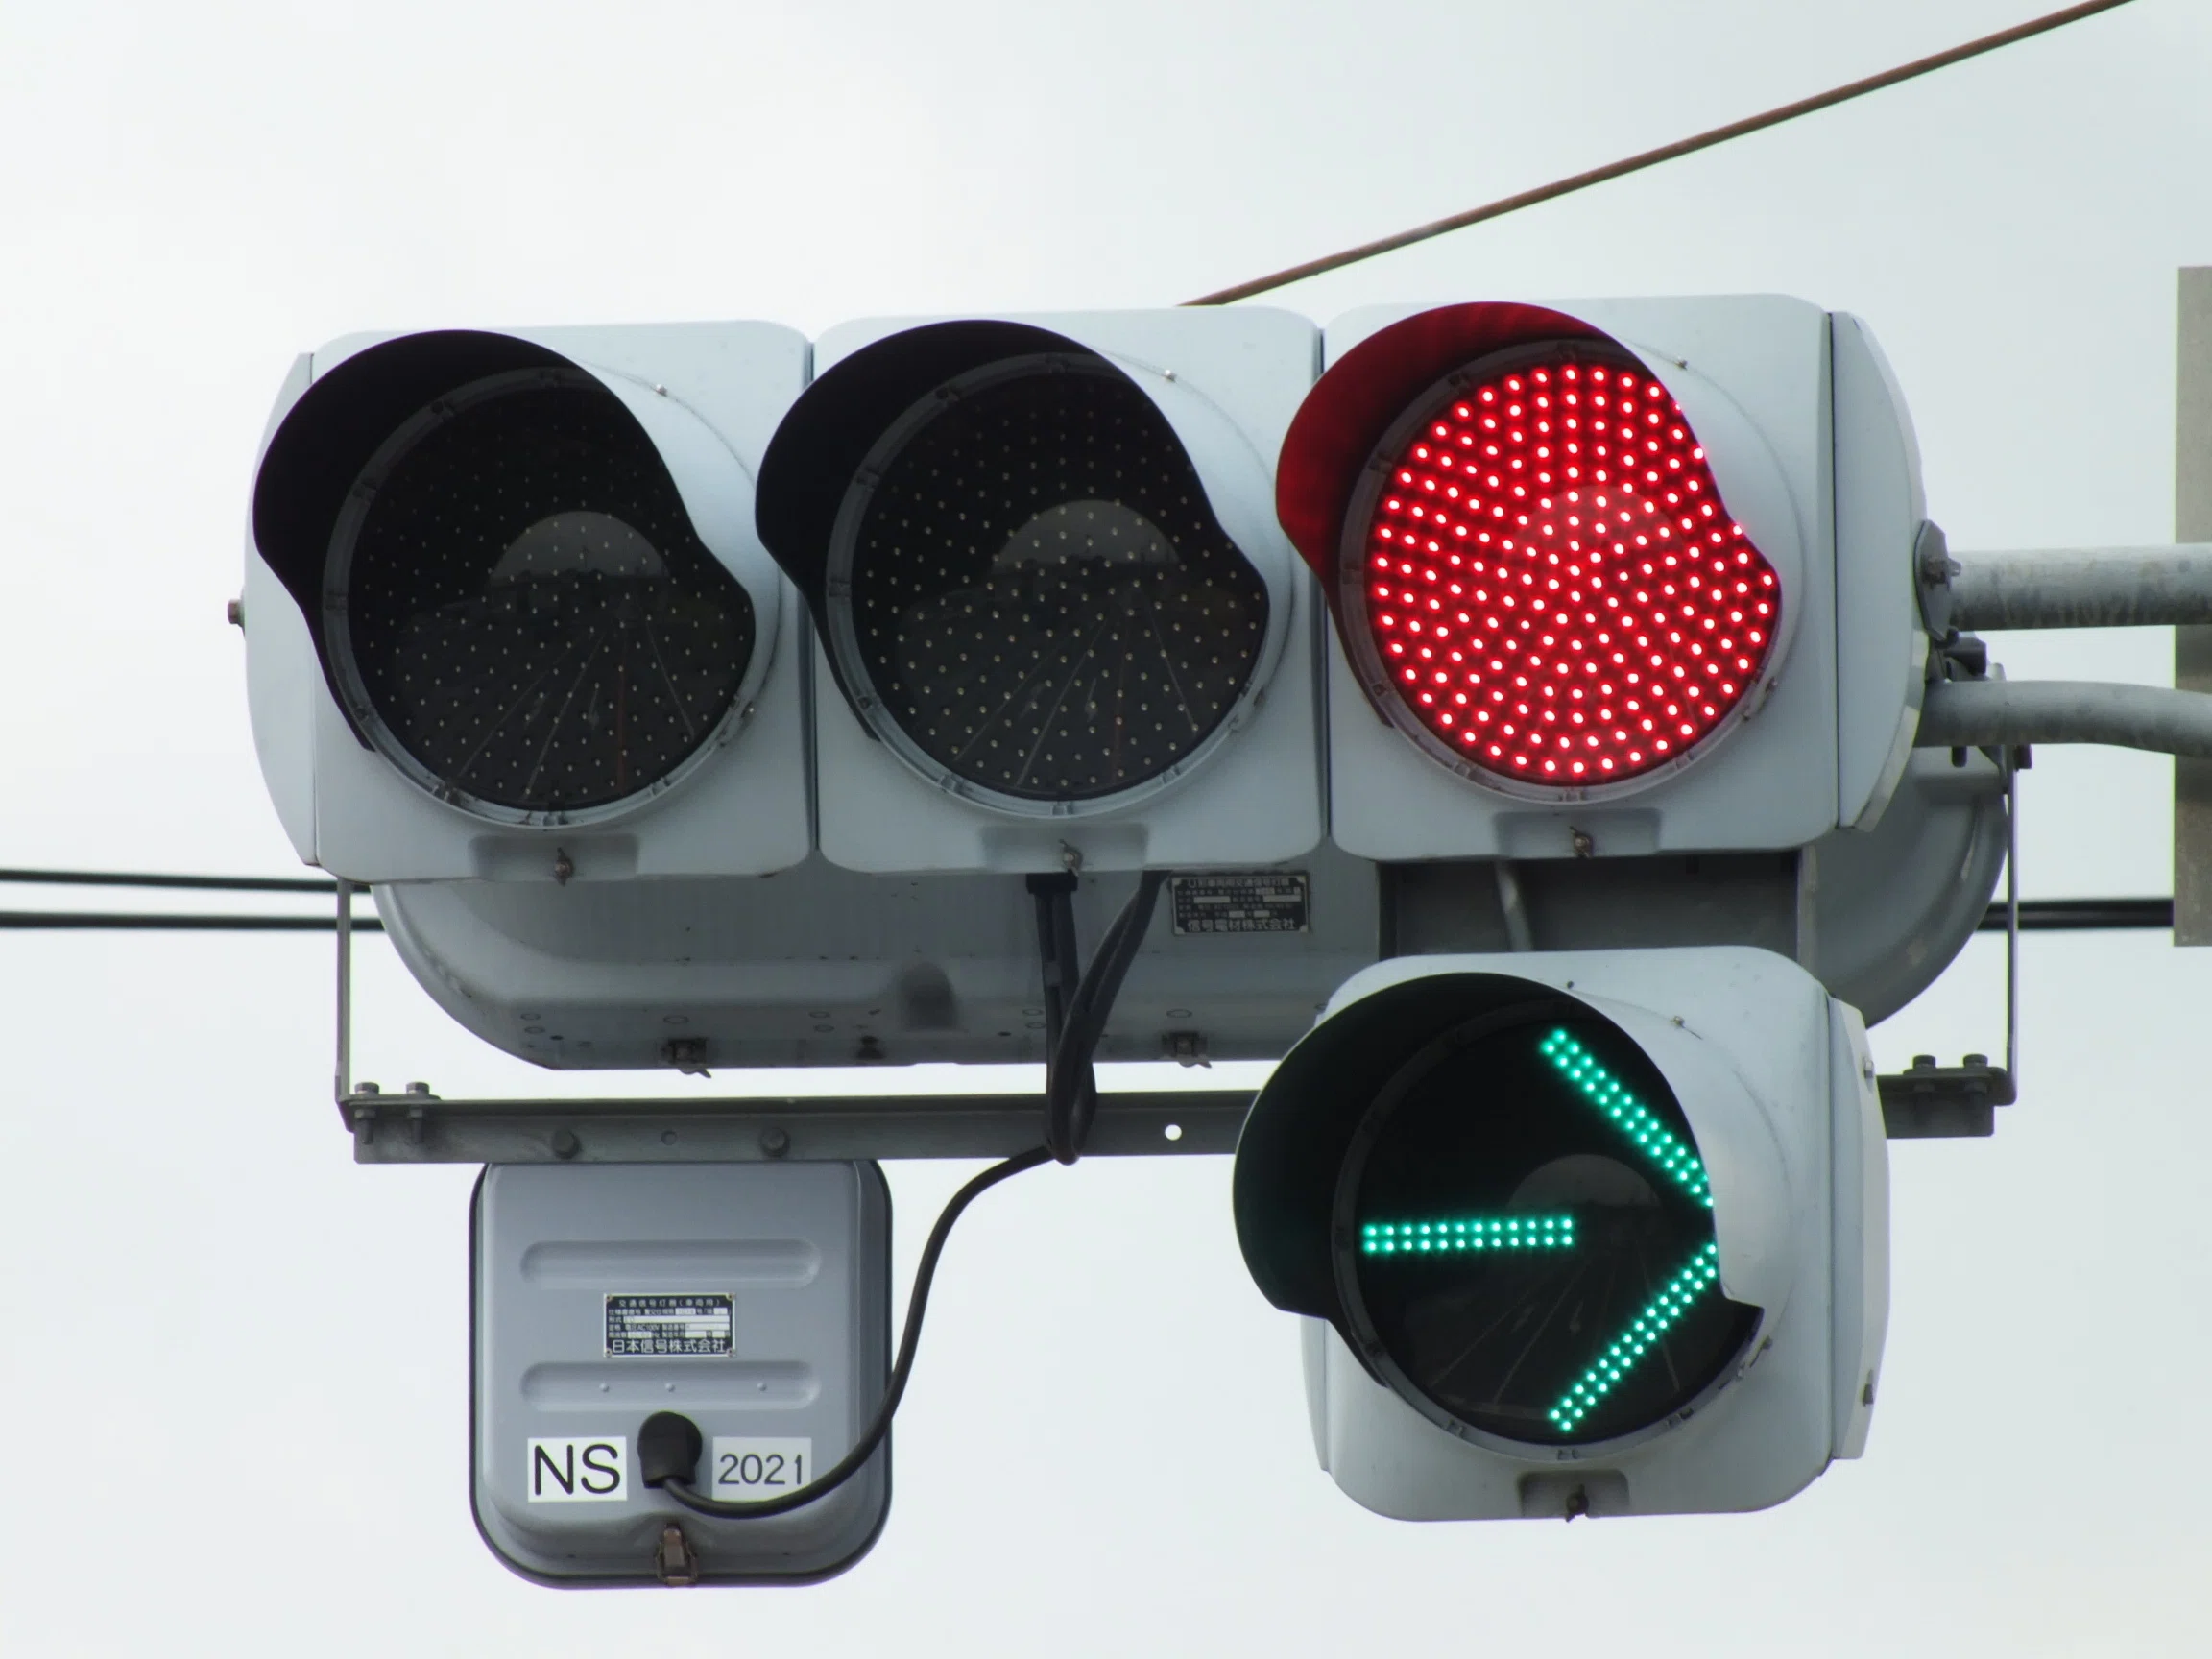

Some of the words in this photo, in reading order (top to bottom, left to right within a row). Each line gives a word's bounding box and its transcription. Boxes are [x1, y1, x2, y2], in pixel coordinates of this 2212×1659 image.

[1189, 919, 1296, 932] 信号電材株式会社
[613, 1339, 726, 1354] 日本信号株式会社
[534, 1444, 620, 1496] NS
[718, 1454, 803, 1486] 2021
